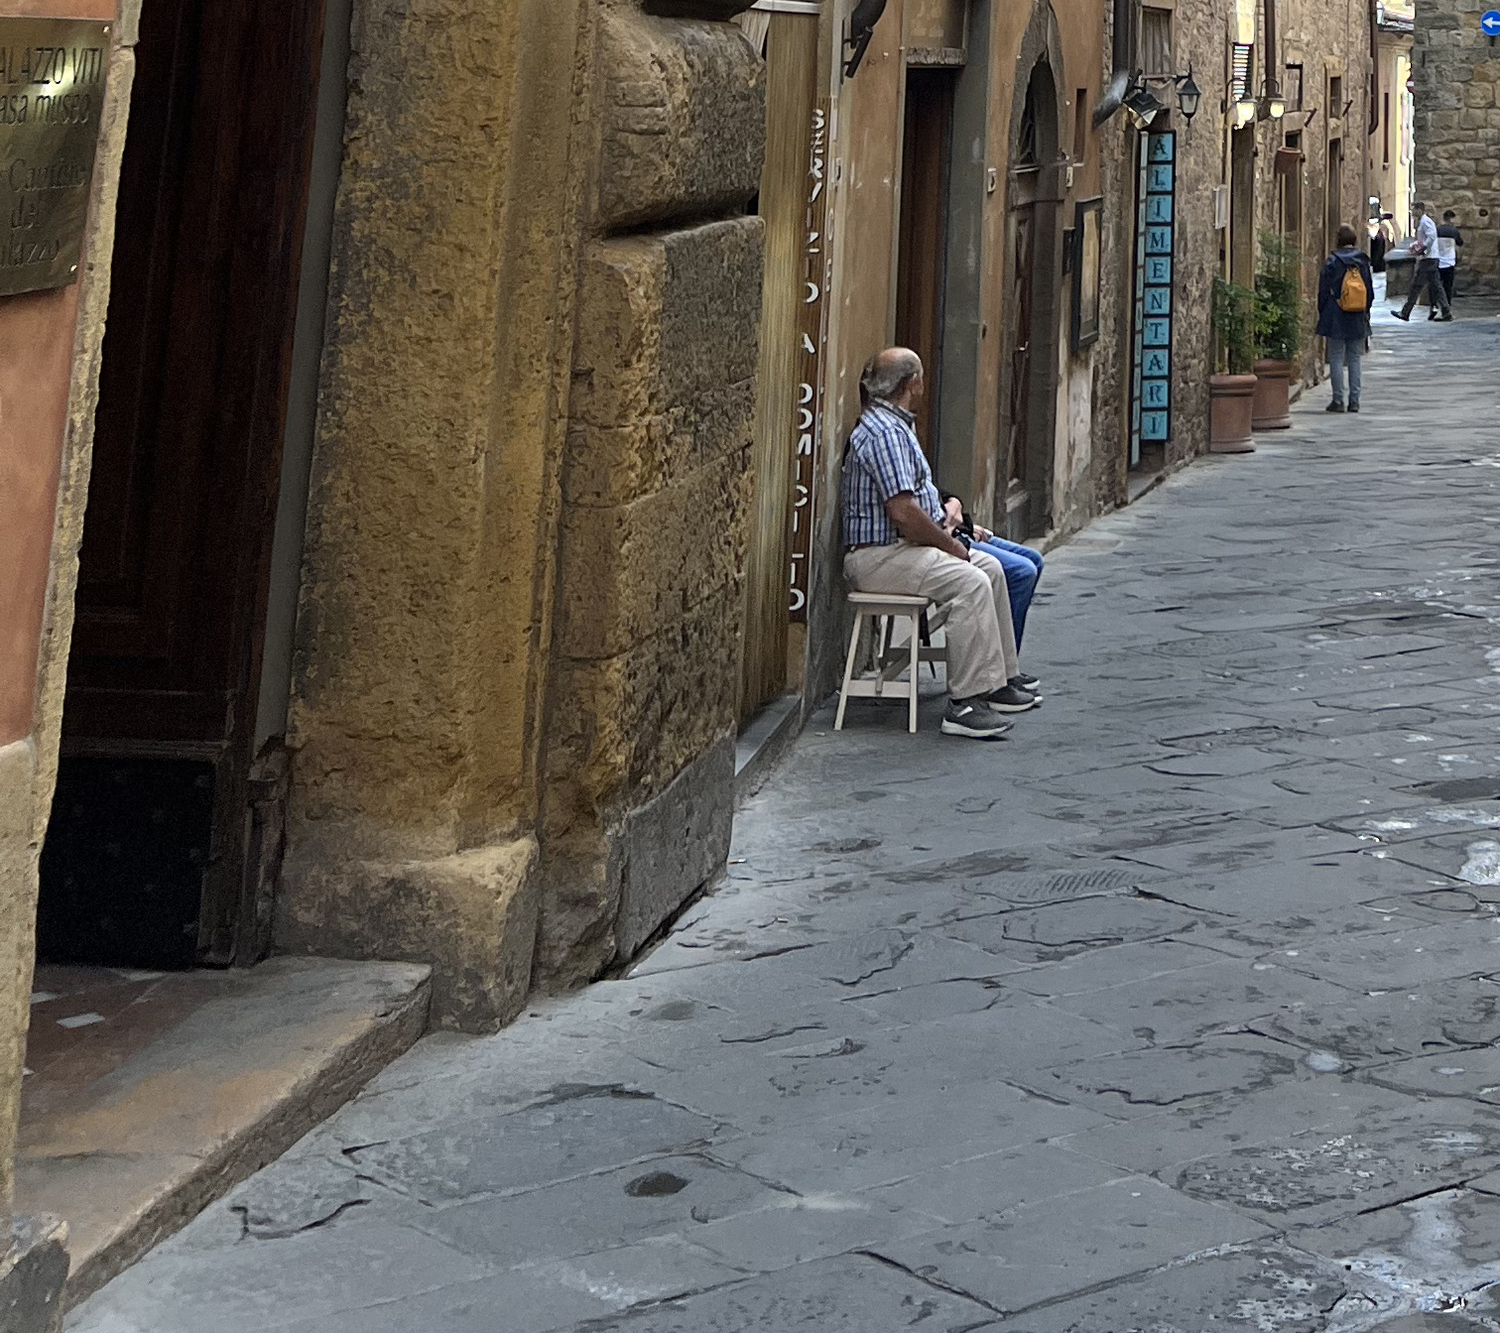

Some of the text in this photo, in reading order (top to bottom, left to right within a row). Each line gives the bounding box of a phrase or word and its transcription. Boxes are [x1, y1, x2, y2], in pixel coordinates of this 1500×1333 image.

[72, 47, 104, 85] VITI
[35, 93, 91, 126] museo
[1146, 136, 1167, 434] ALIMENTARI
